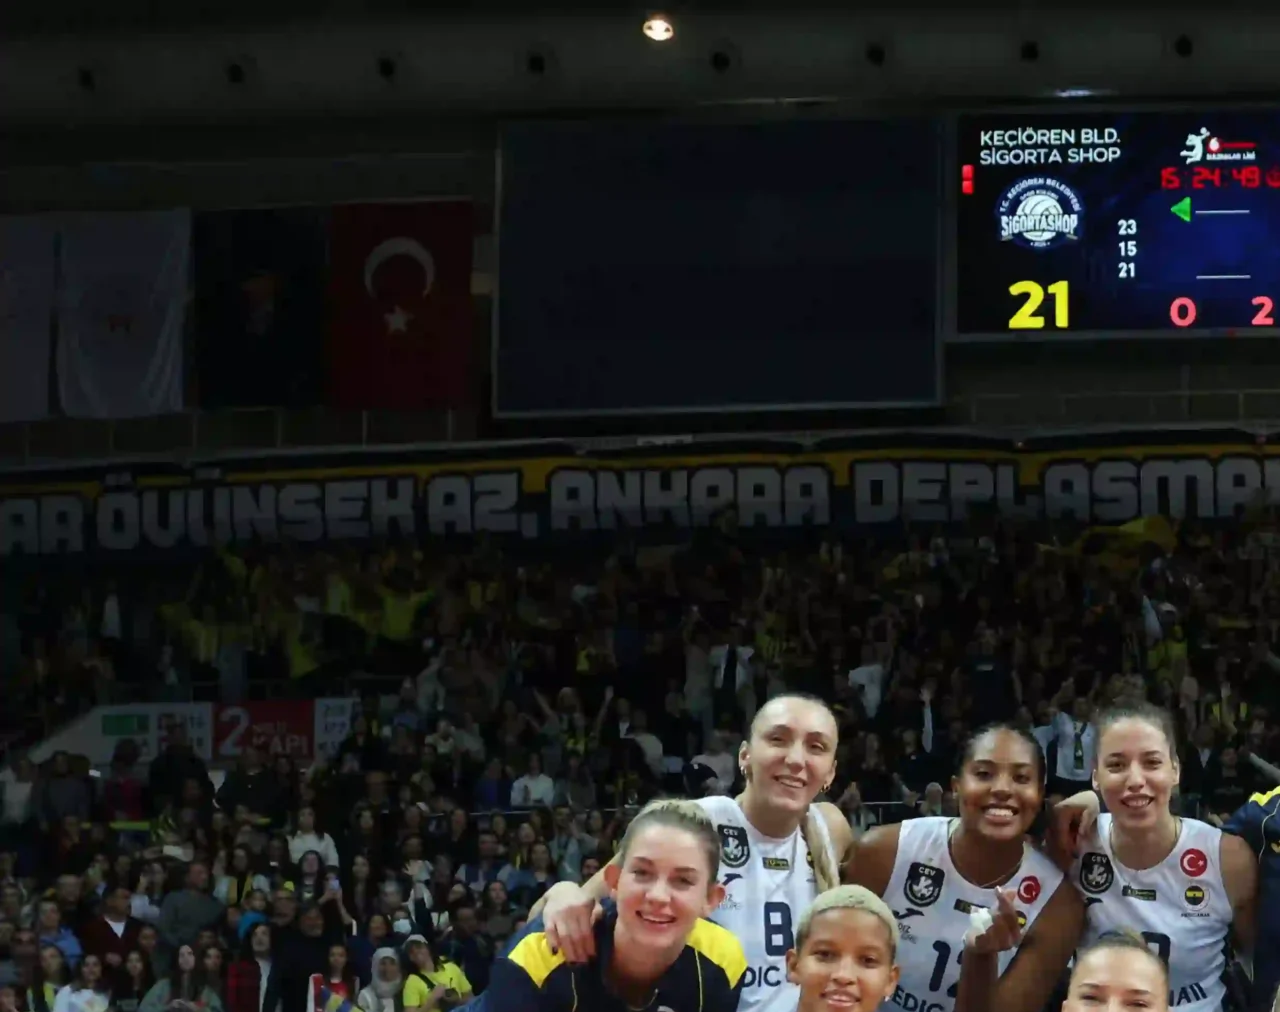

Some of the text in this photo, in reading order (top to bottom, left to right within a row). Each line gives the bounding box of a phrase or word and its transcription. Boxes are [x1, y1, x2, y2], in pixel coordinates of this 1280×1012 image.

[980, 127, 1121, 147] KEÇİÖREN BLD.
[980, 147, 1122, 165] SİGORTA SHOP
[1117, 219, 1137, 235] 23
[1118, 240, 1138, 257] 15
[1117, 262, 1137, 279] 21
[1007, 280, 1070, 329] 21
[1170, 297, 1197, 326] 0
[1251, 295, 1275, 326] 2
[550, 464, 830, 531] ANKARA
[219, 705, 250, 757] 2
[919, 866, 937, 876] CEV
[764, 901, 794, 957] 8
